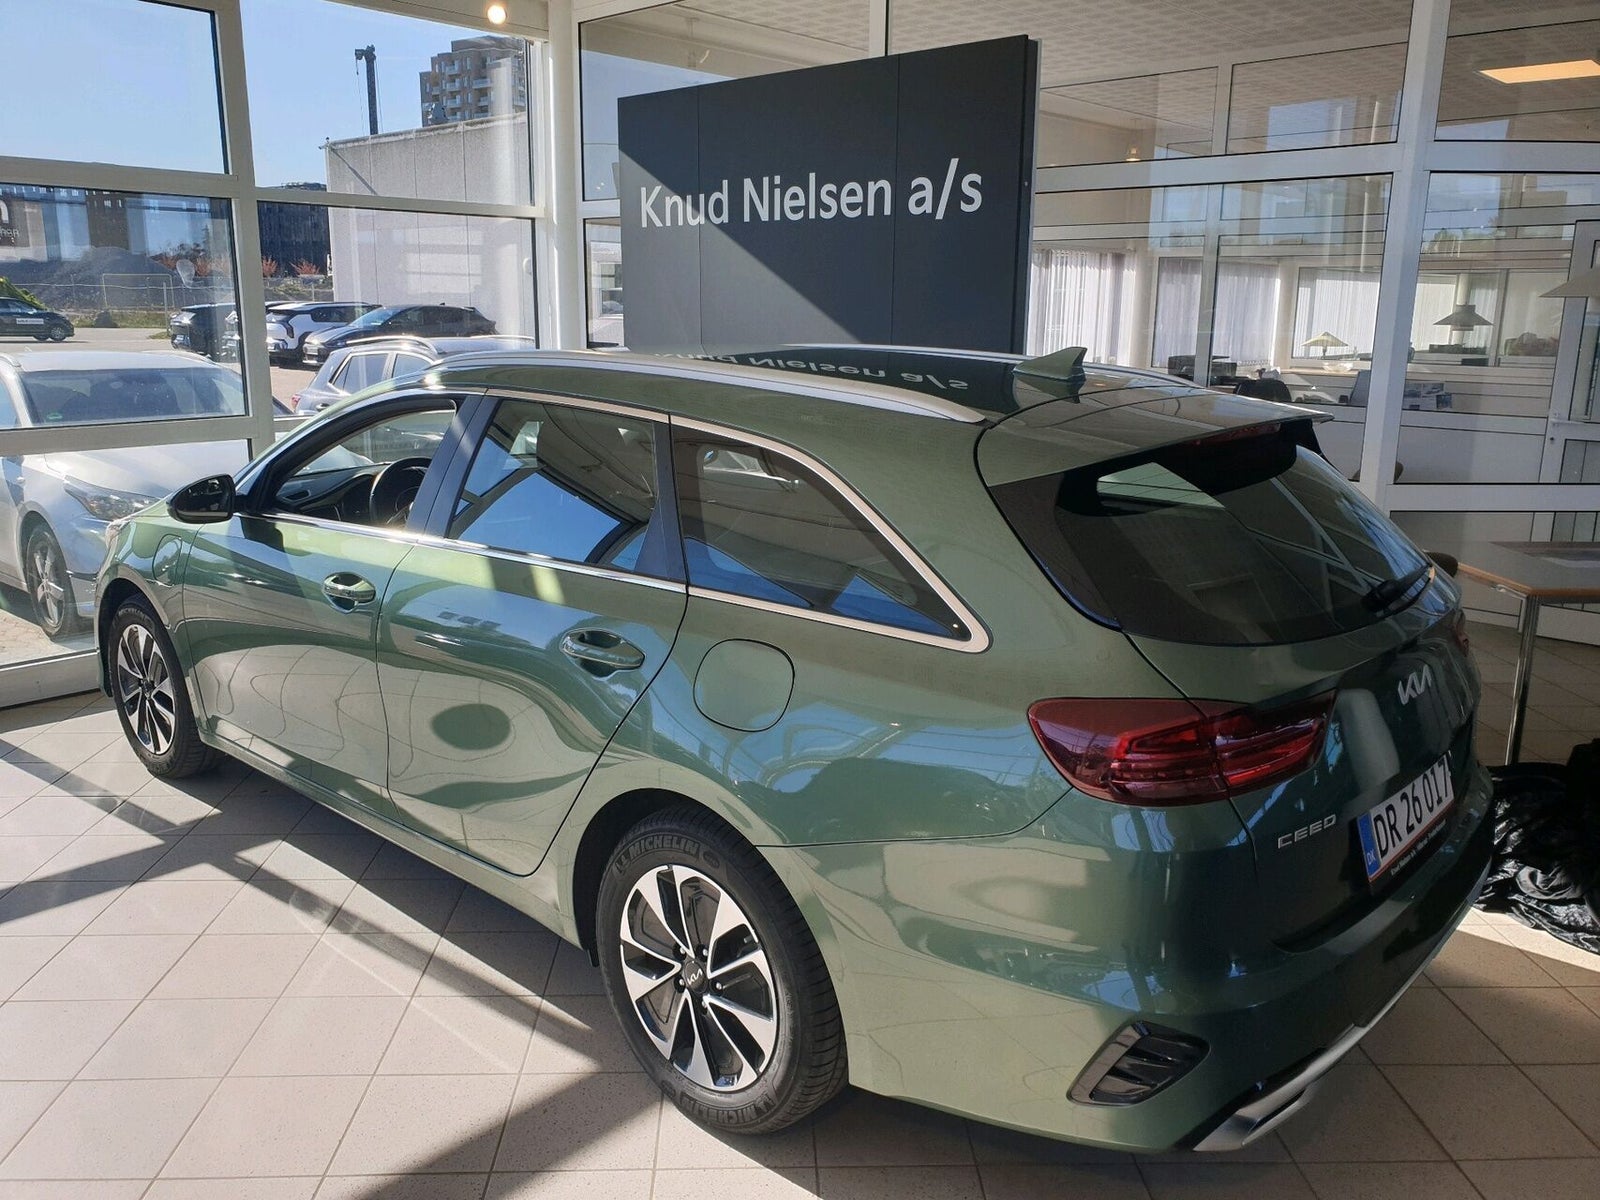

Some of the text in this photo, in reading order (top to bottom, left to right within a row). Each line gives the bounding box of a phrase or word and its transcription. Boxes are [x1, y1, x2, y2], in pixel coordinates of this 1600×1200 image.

[640, 157, 983, 228] Knud Nielsen a/s
[1278, 814, 1337, 849] CEED
[1373, 803, 1403, 859] DR
[1400, 782, 1422, 835] 26
[1422, 758, 1449, 813] 017
[628, 834, 700, 860] MICHELIN
